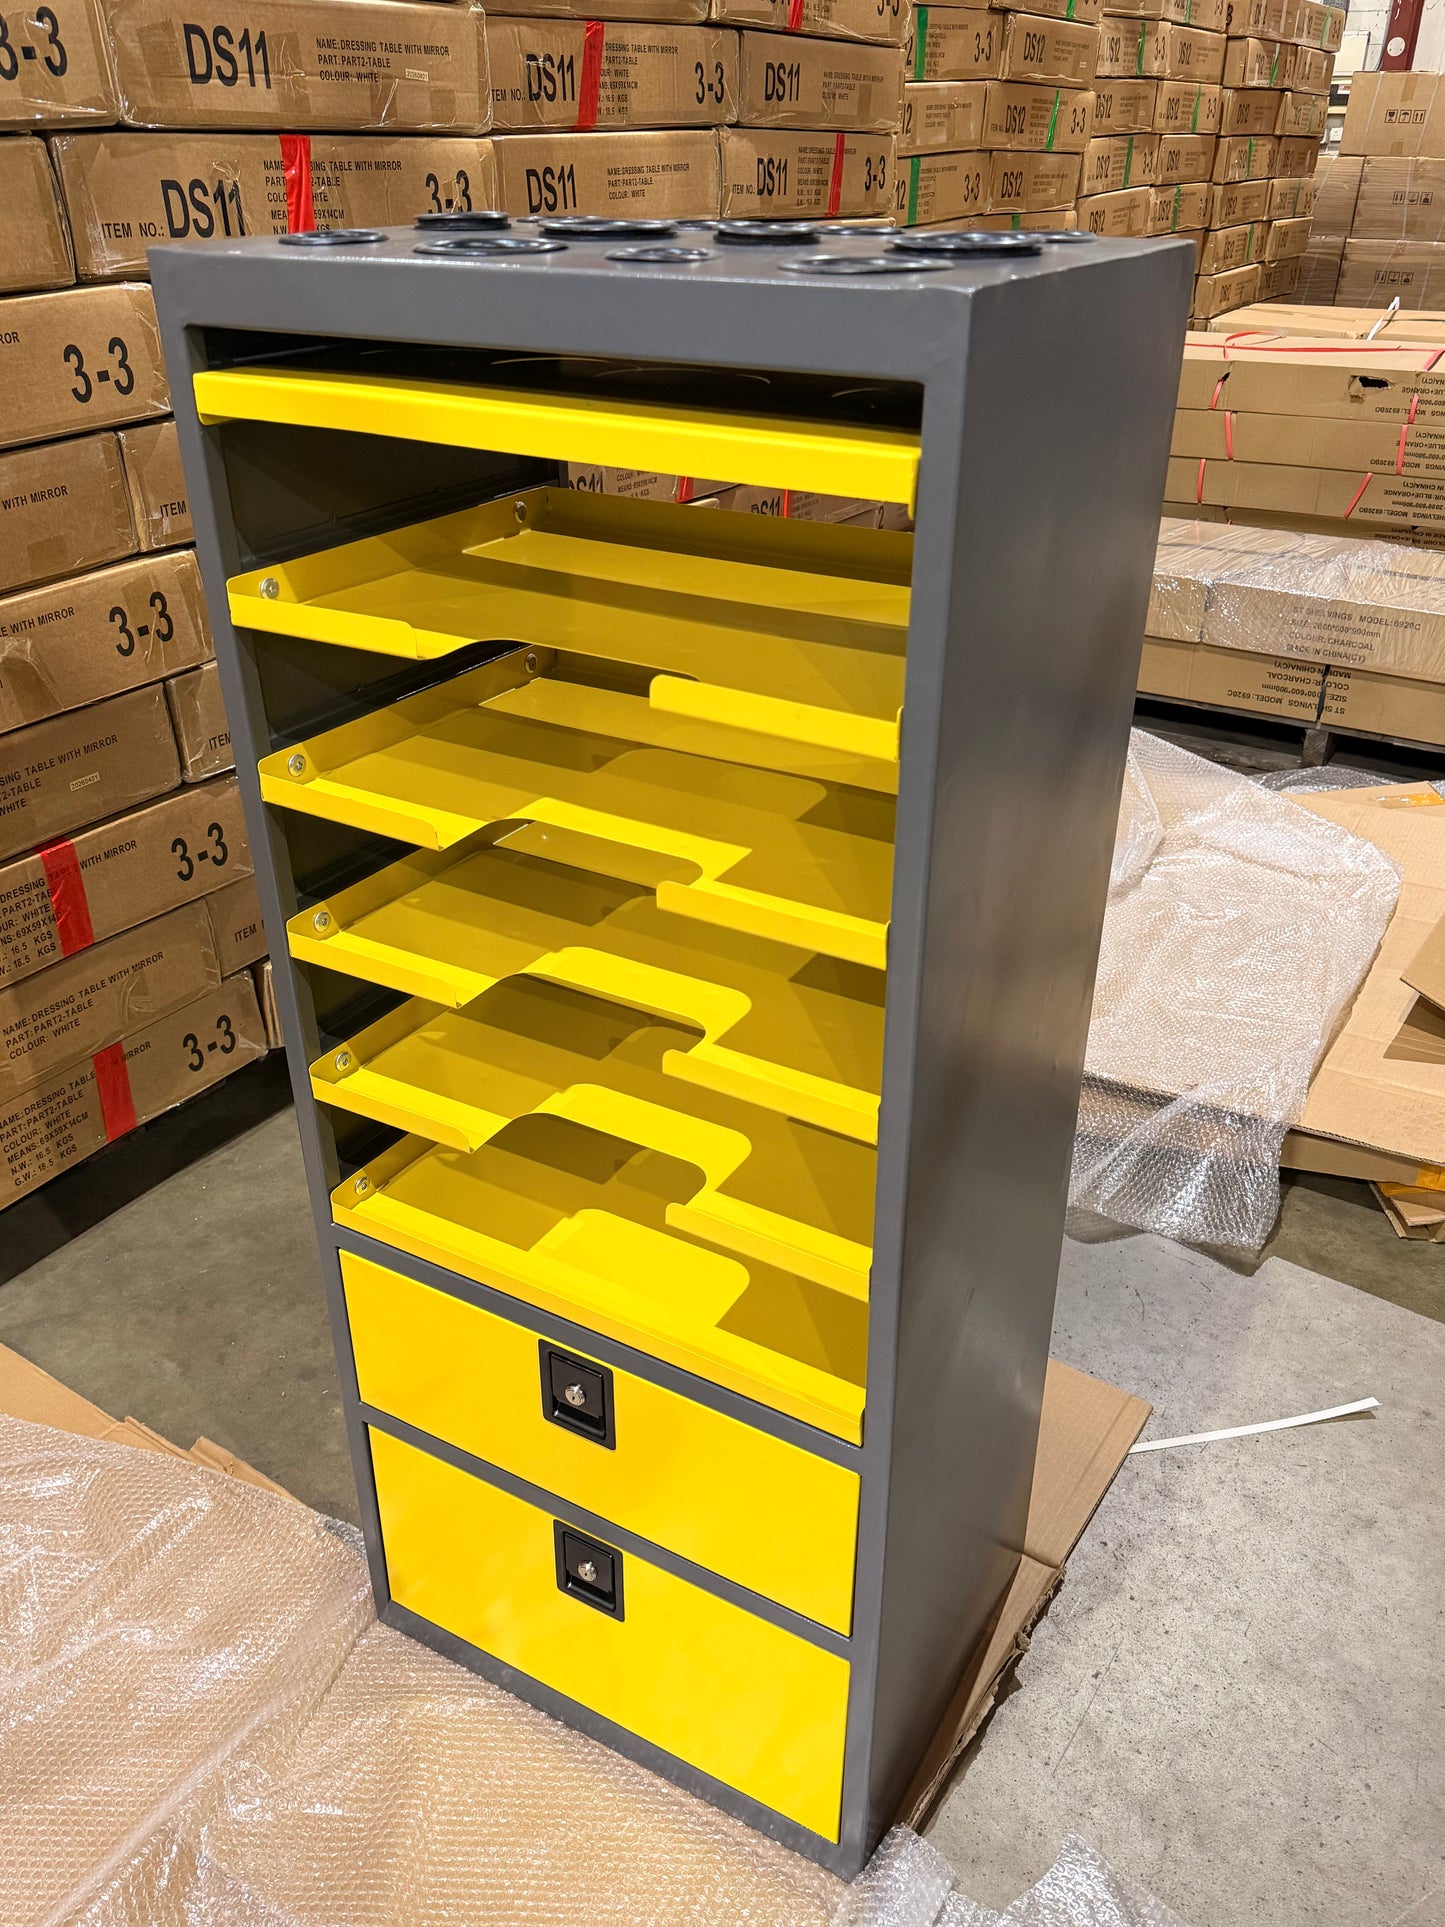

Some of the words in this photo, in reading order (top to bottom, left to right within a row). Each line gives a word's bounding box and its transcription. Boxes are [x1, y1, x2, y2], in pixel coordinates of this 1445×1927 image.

[183, 23, 272, 89] DS11
[379, 42, 403, 54] TABLE
[404, 44, 422, 55] WITH
[423, 45, 450, 56] MIRROR
[631, 44, 647, 54] TABLE
[647, 45, 660, 54] WITH
[974, 30, 992, 64] 3-3
[1023, 31, 1046, 64] DS12
[1154, 36, 1166, 61] 3-3
[319, 70, 353, 82] COLOUR:
[356, 71, 379, 83] WHITE
[526, 53, 575, 102] DS11
[694, 61, 725, 104] 3-3
[764, 62, 801, 102] DS11
[1005, 104, 1026, 134] DS12
[1070, 107, 1086, 135] 3-3
[329, 161, 353, 172] TABLE
[354, 160, 373, 171] WITH
[374, 160, 402, 171] MIRROR
[645, 164, 661, 174] TABLE
[661, 163, 673, 173] WITH
[672, 163, 690, 172] MIRROR
[732, 184, 744, 195] ITEM
[757, 157, 788, 197] DS11
[864, 155, 886, 192] 3-3
[311, 192, 328, 202] HITE
[425, 169, 472, 214] 3-3
[525, 163, 577, 214] DS11
[631, 189, 646, 199] WHITE
[963, 172, 980, 203] 3-3
[1001, 170, 1023, 199] DS12
[101, 222, 133, 239] ITEM
[139, 222, 164, 238] NO.:
[161, 178, 246, 239] DS11
[63, 336, 134, 403] 3-3
[2, 494, 28, 511] WITH
[30, 485, 69, 503] MIRROR
[159, 500, 187, 518] ITEM
[10, 618, 35, 635] WITH
[37, 606, 75, 626] MIRROR
[109, 591, 174, 657] 3-3
[1274, 660, 1316, 674] CHINA(CY)
[1322, 649, 1366, 664] CHINA(CY)
[24, 757, 56, 776] TABLE
[57, 747, 82, 764] WITH
[83, 734, 118, 754] MIRROR
[80, 854, 102, 870] WITH
[103, 840, 138, 861] MIRROR
[171, 822, 229, 882] 3-3
[22, 903, 50, 922] WHITE
[11, 943, 28, 955] 16.5
[33, 930, 53, 945] KGS
[234, 923, 257, 943] ITEM
[13, 957, 31, 970] 18.5
[38, 942, 57, 958] KGS
[78, 979, 107, 999] TABLE
[108, 967, 130, 984] WITH
[131, 951, 164, 973] MIRROR
[9, 1035, 50, 1060] COLOUR:
[52, 1018, 81, 1038] WHITE
[182, 1014, 236, 1072] 3-3
[69, 1071, 97, 1091] TABLE
[3, 1127, 42, 1154] COLOUR:
[44, 1109, 71, 1130] WHITE
[35, 1147, 51, 1161] 16.5
[55, 1133, 74, 1149] KGS
[38, 1158, 54, 1173] 18.5
[59, 1144, 78, 1160] KGS
